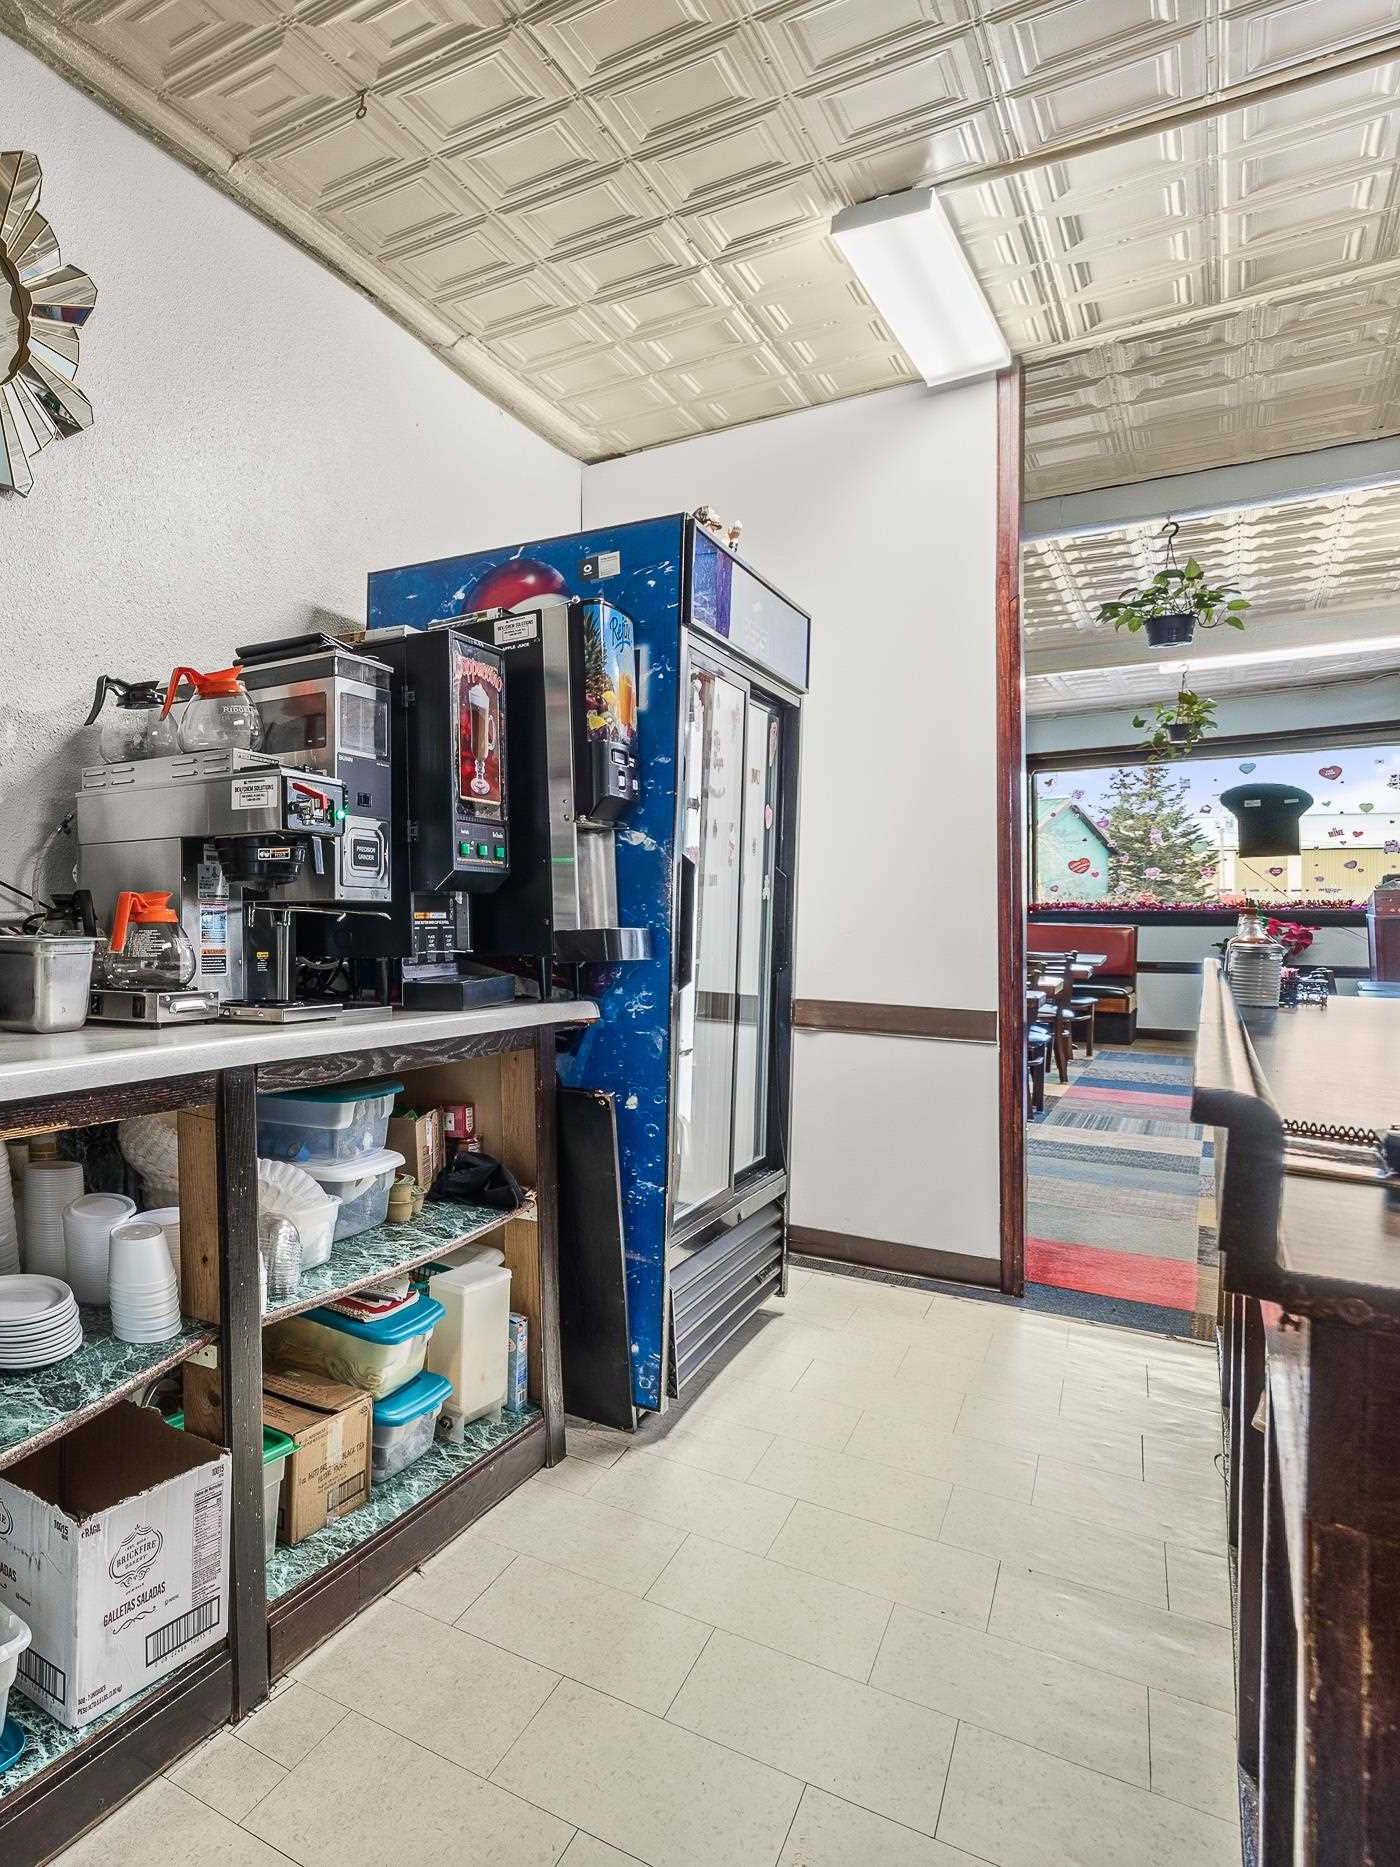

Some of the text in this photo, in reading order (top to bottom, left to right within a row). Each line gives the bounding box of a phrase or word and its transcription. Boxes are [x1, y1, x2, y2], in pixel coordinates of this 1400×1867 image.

[116, 1540, 157, 1568] BRICKFIRE
[103, 1599, 136, 1628] GALLETAS
[136, 1581, 166, 1607] SALADAS
